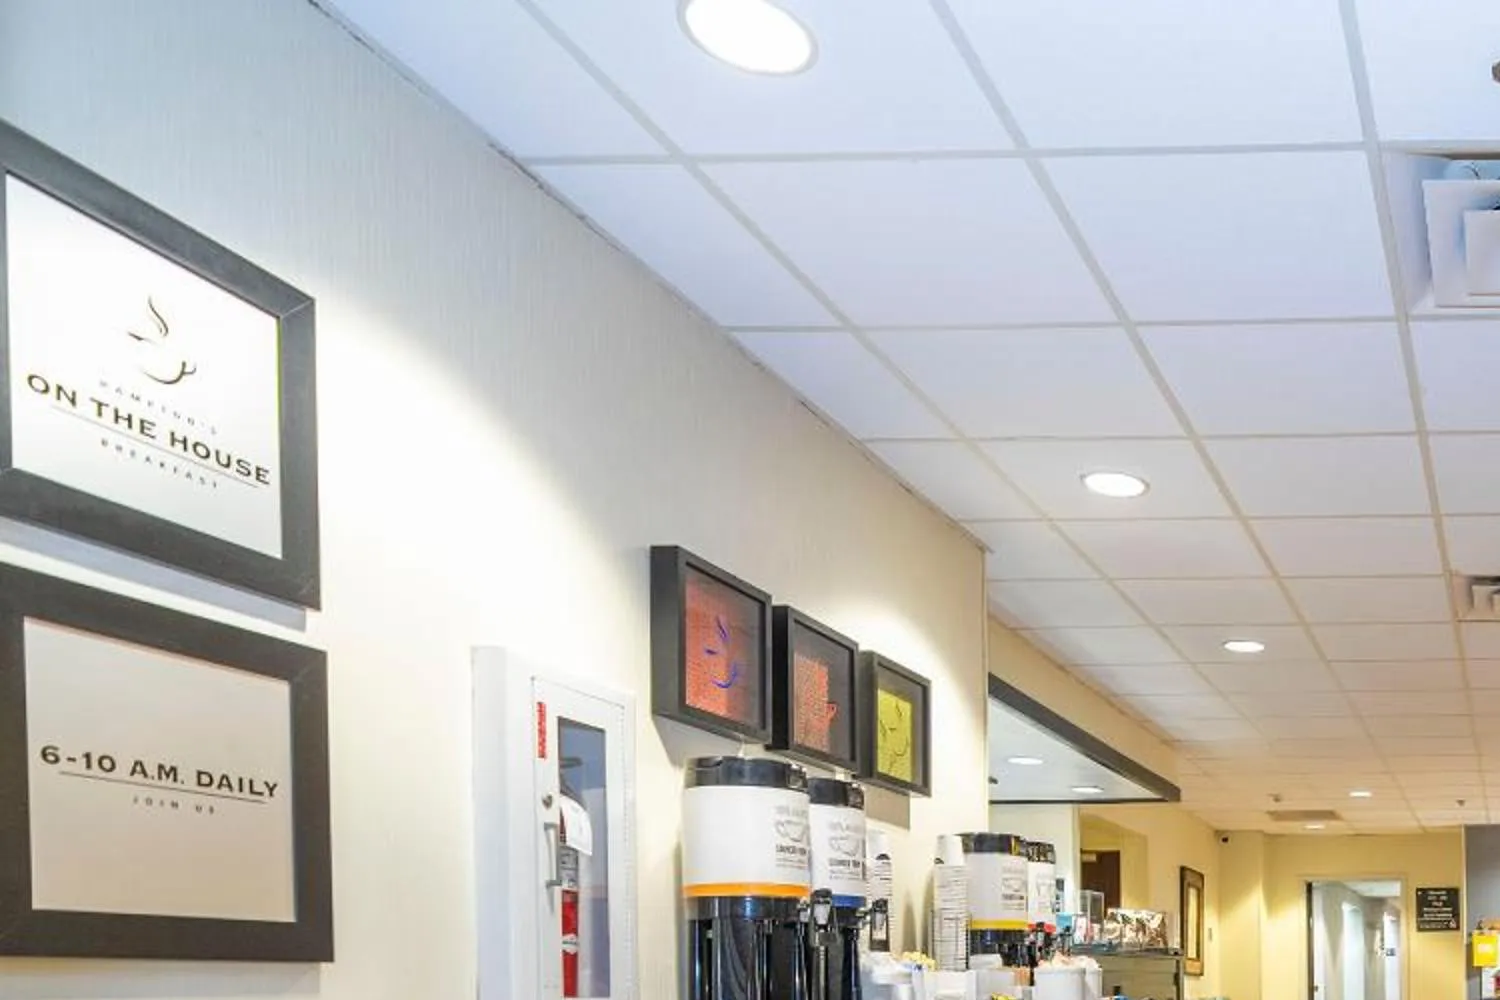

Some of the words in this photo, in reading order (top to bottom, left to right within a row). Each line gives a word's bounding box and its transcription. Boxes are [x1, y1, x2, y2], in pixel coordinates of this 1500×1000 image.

[26, 373, 77, 408] ON
[89, 396, 156, 439] THE
[168, 430, 270, 486] HOUSE
[40, 744, 117, 773] 6-10
[129, 759, 185, 785] A.M.
[195, 769, 278, 798] DAILY
[132, 795, 179, 809] JOIN
